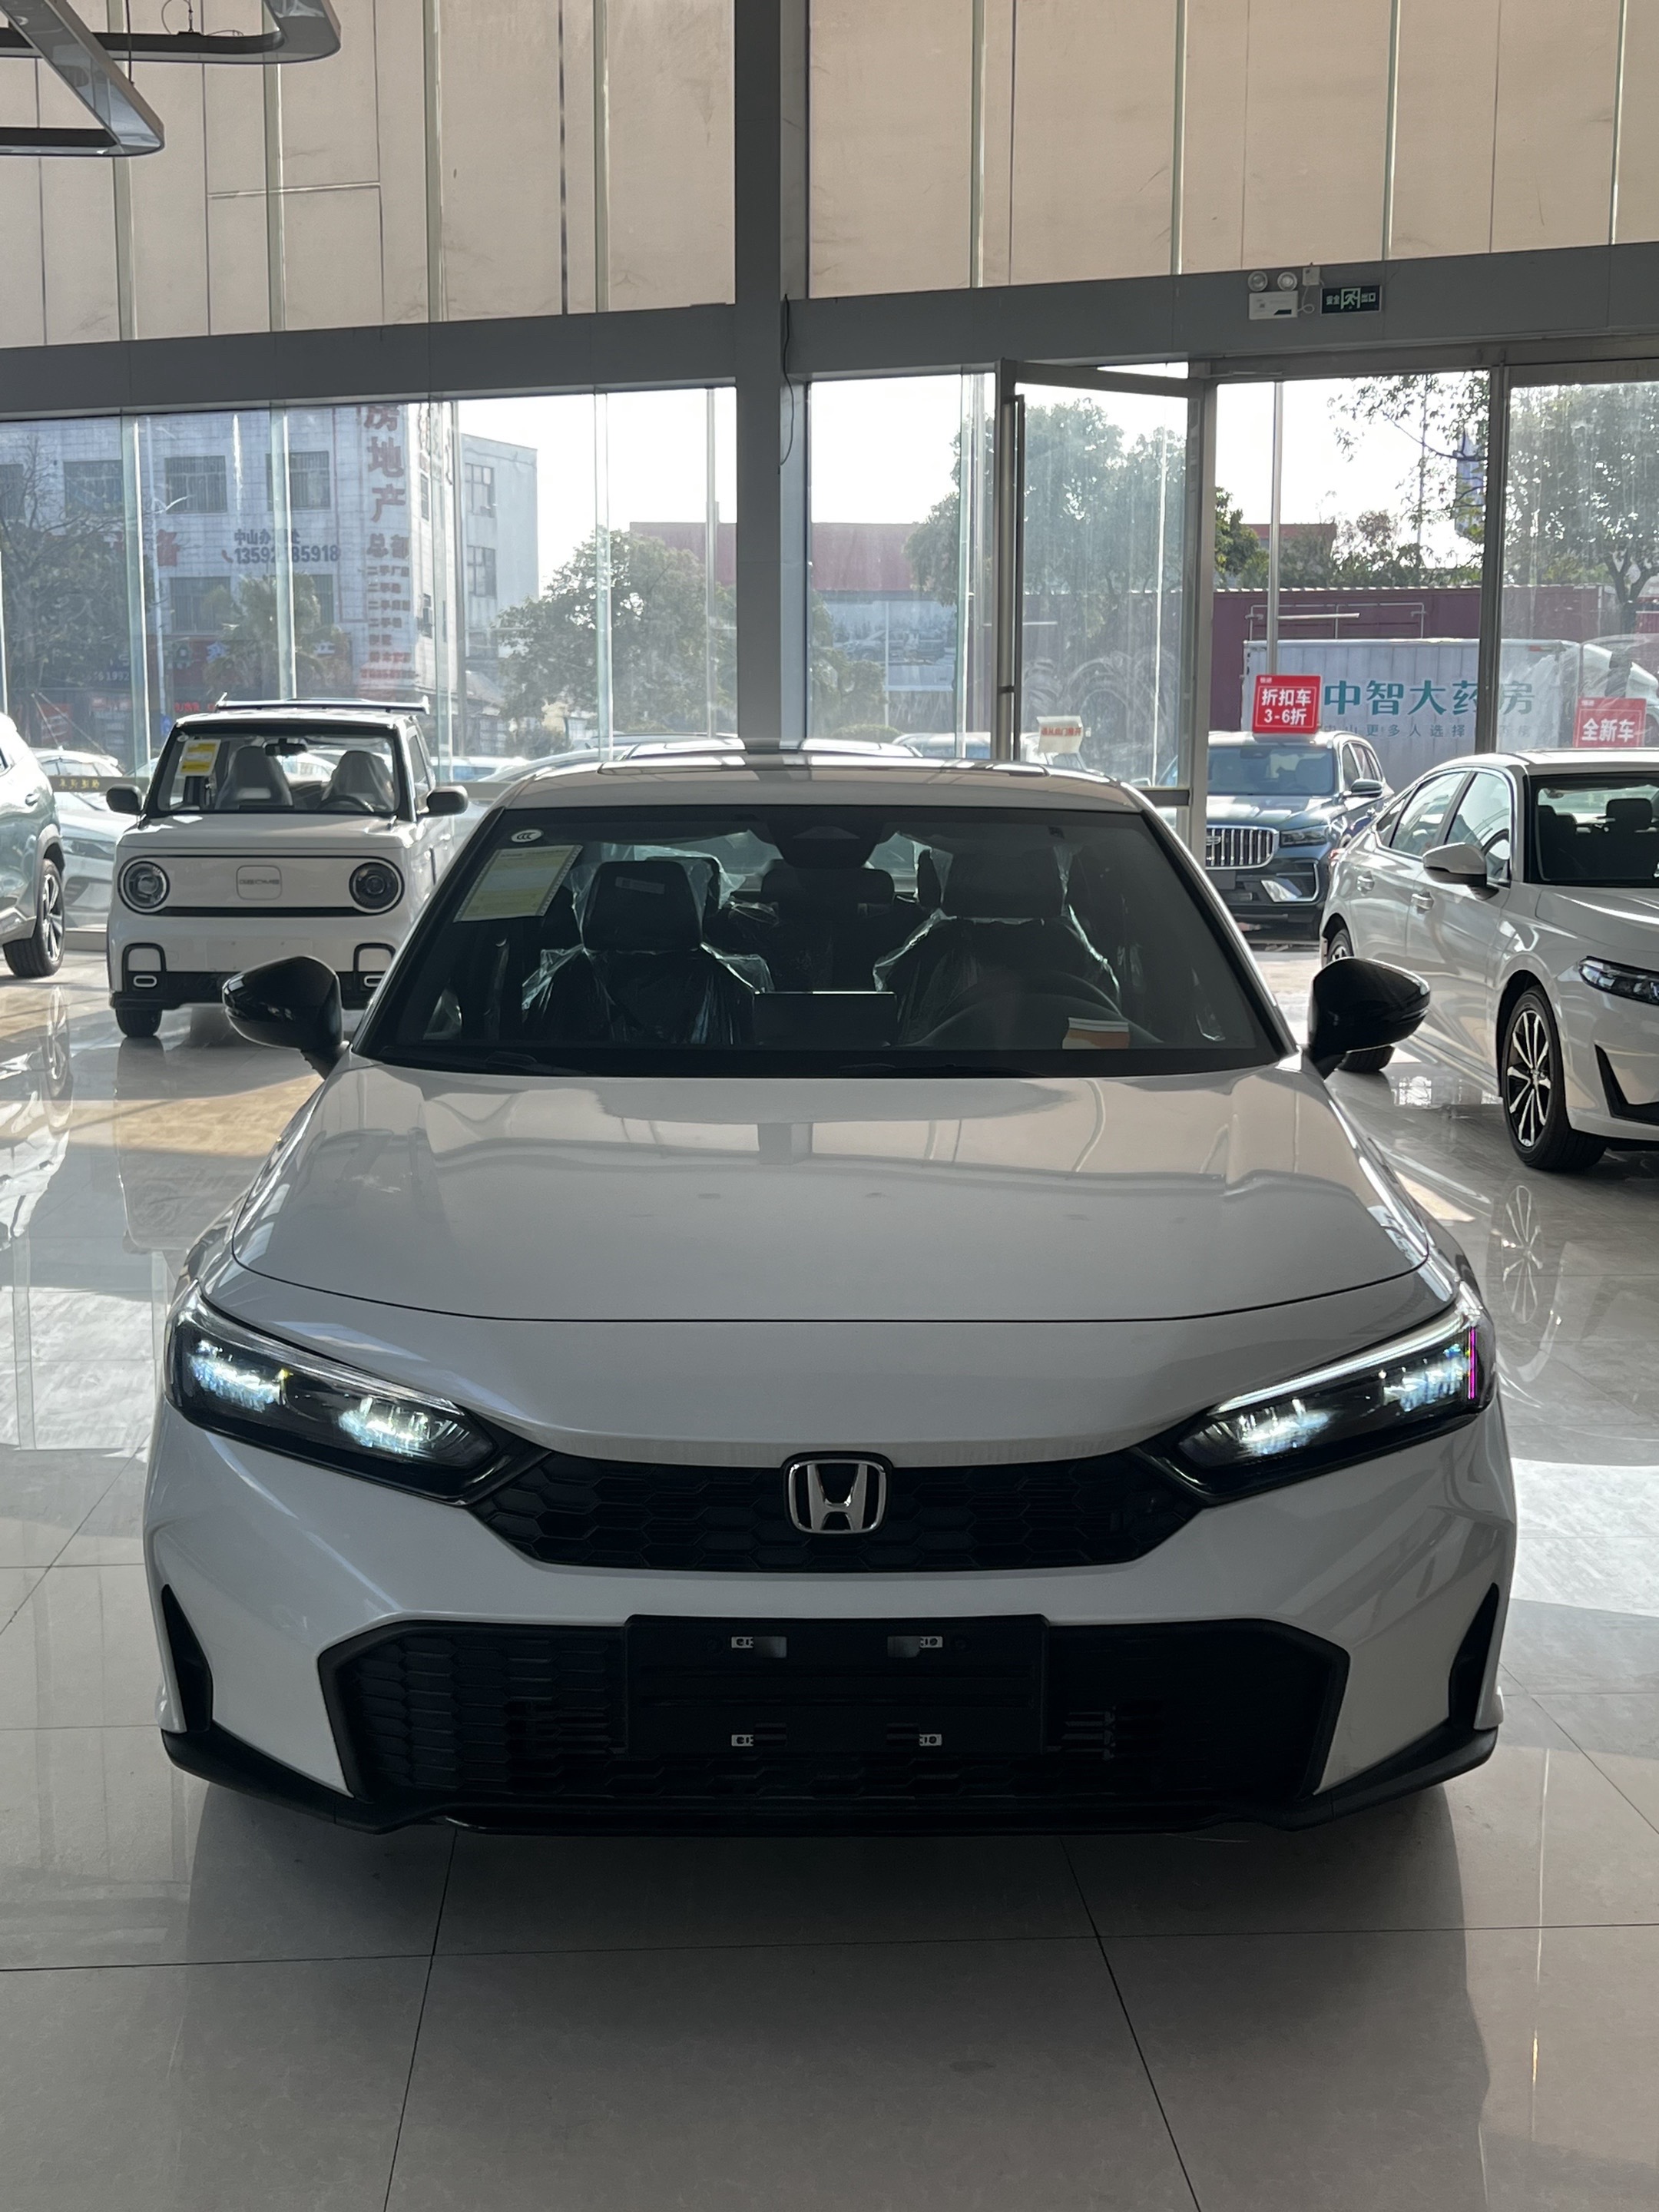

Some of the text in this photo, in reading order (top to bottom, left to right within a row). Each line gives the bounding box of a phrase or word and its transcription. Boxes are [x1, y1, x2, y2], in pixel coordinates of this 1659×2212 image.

[1361, 293, 1376, 303] 出口
[234, 545, 339, 565] 1359285918
[1261, 687, 1312, 707] 折扣车
[1323, 680, 1535, 716] 中智大药房
[1263, 707, 1307, 726] 3-6折
[1581, 717, 1635, 743] 全新车
